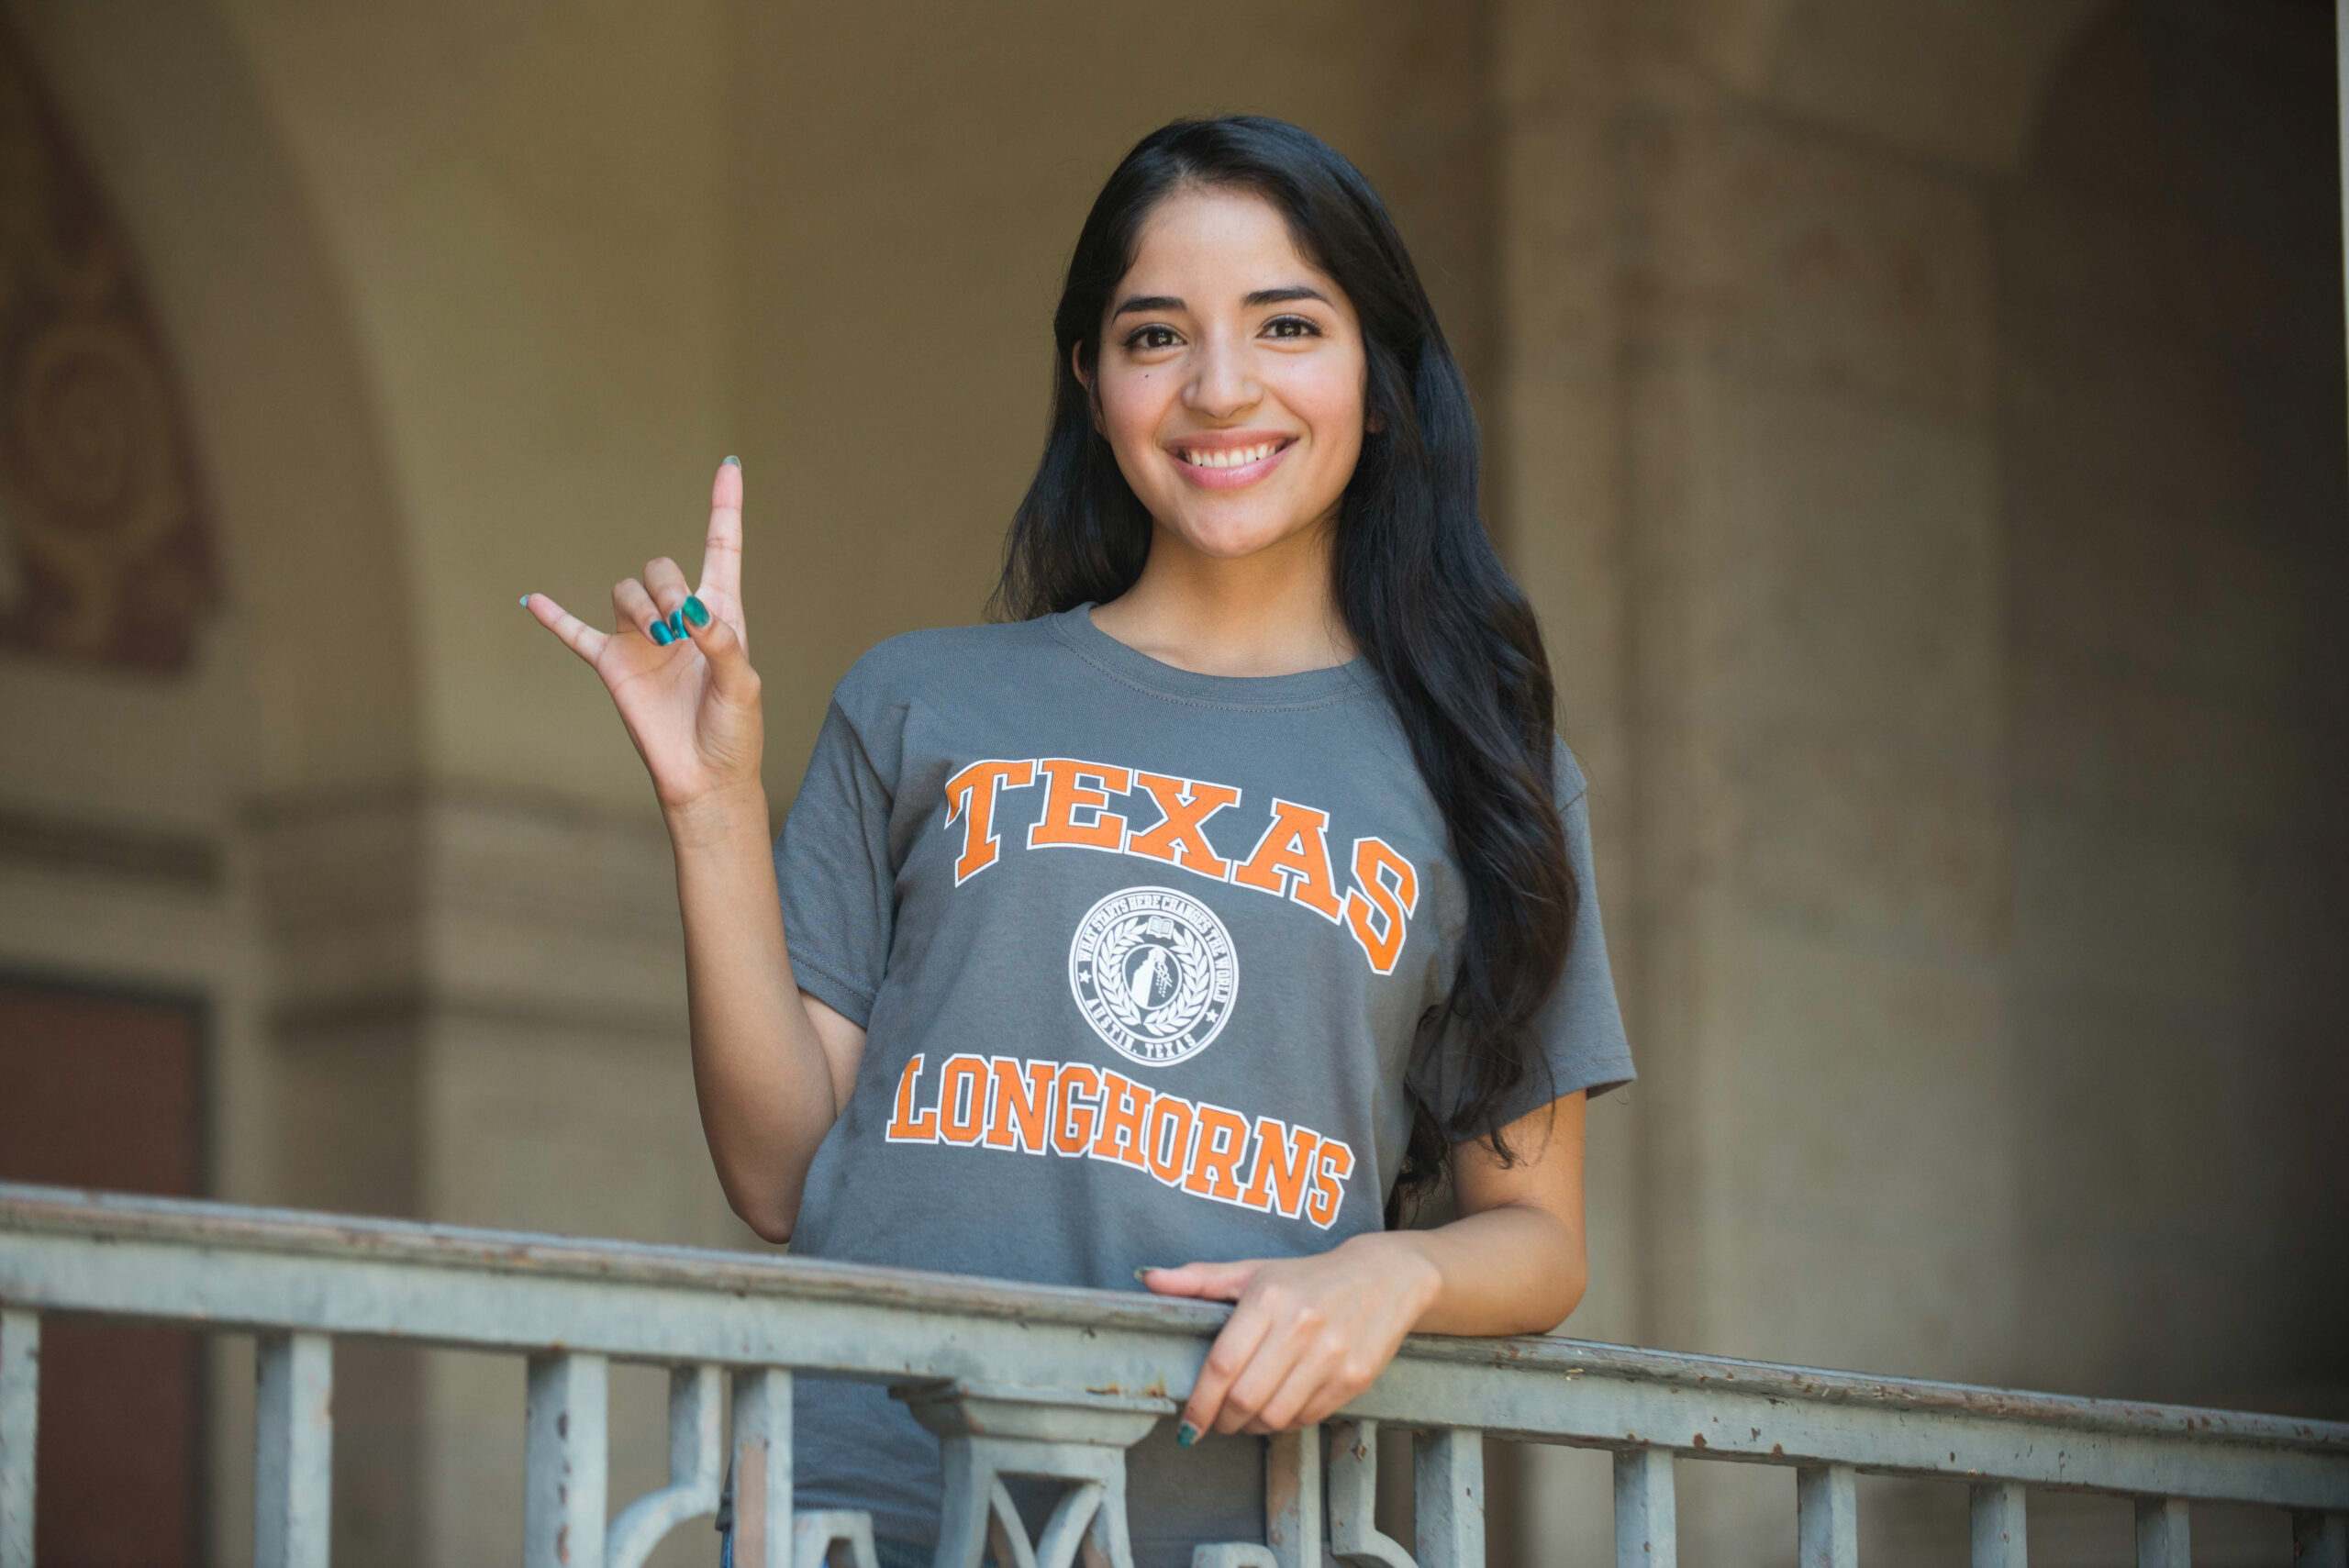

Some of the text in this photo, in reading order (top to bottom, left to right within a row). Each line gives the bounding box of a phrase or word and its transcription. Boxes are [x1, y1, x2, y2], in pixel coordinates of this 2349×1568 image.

[944, 758, 1419, 975] TEXAS
[1090, 898, 1130, 931] STARTS
[1127, 895, 1161, 911] HERE
[1077, 925, 1099, 962] WHAT
[1204, 928, 1227, 957] THE
[1213, 955, 1230, 1003] WORLD
[1145, 1034, 1196, 1058] TEXAS
[885, 1053, 1355, 1229] LONGHORNS
